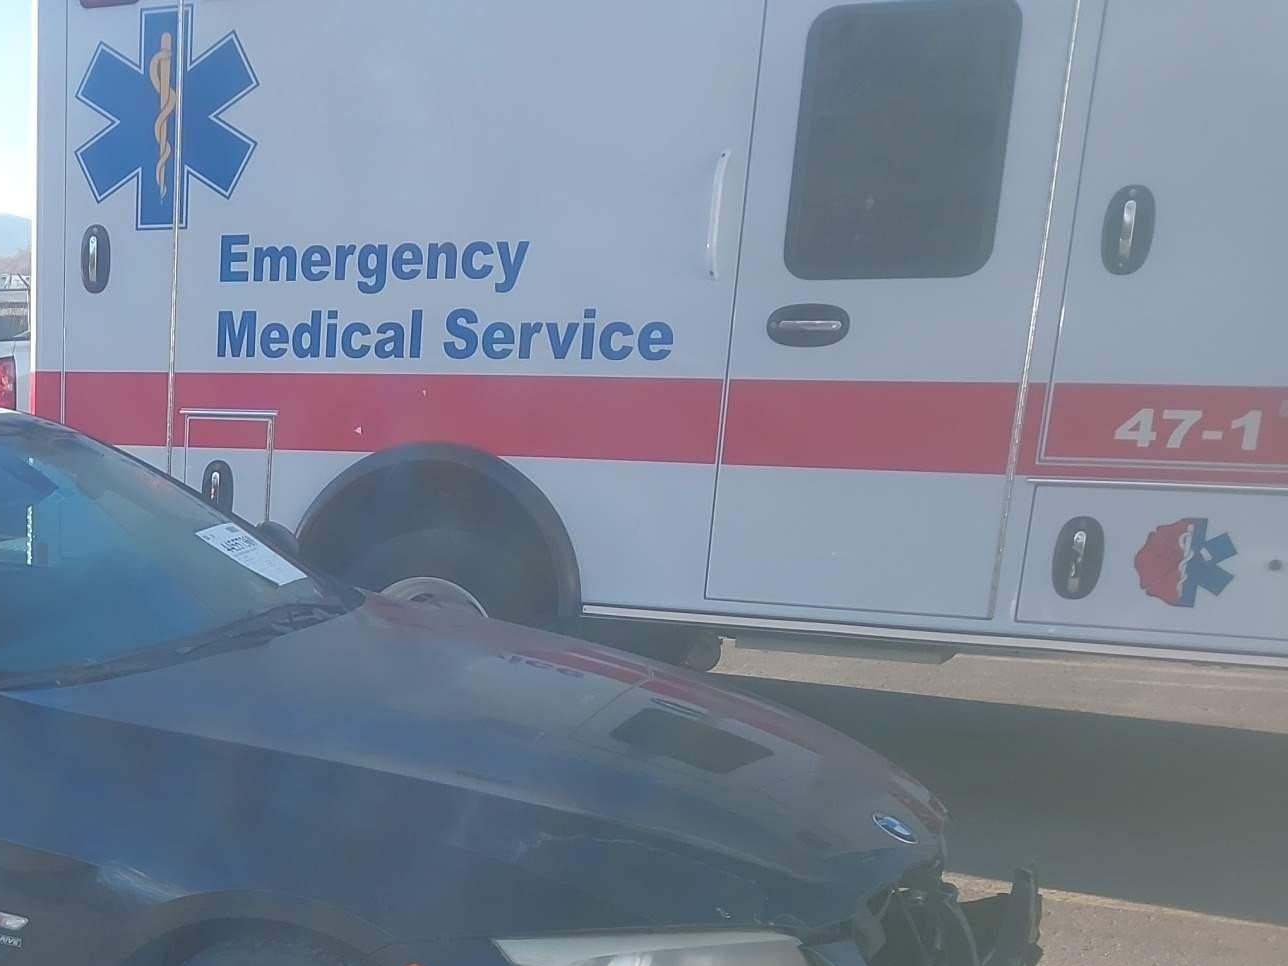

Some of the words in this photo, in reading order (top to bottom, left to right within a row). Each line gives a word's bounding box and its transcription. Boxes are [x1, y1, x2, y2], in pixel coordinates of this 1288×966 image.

[219, 234, 530, 295] Emergency
[216, 309, 423, 359] Medical
[443, 308, 674, 361] Service
[1114, 408, 1263, 451] 47-1
